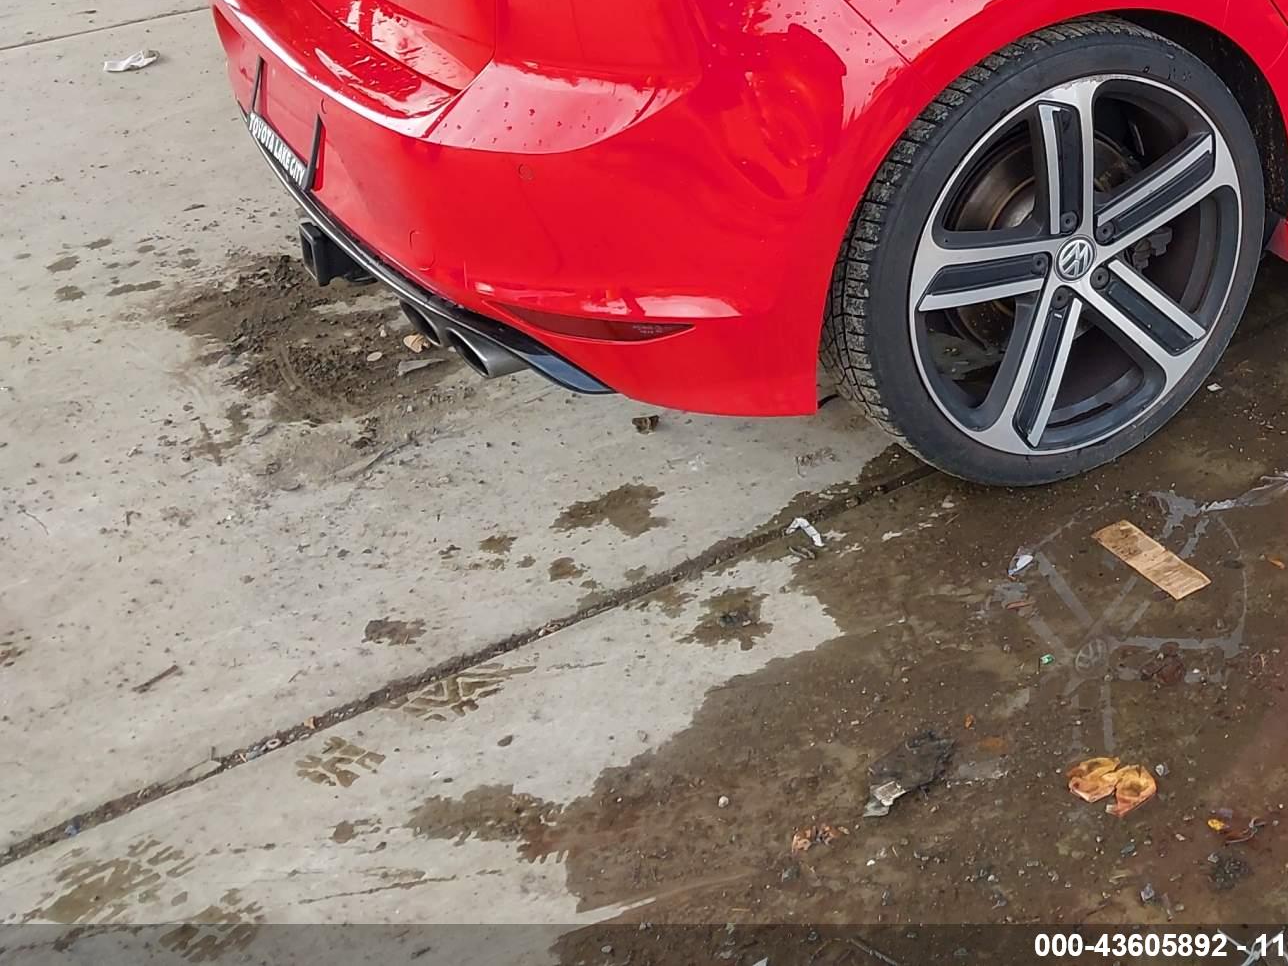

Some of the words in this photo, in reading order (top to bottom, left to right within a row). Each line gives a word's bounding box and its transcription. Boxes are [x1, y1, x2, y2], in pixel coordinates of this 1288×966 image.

[248, 113, 275, 153] TOYOTA
[273, 138, 292, 171] LAKE
[289, 154, 306, 186] CITY
